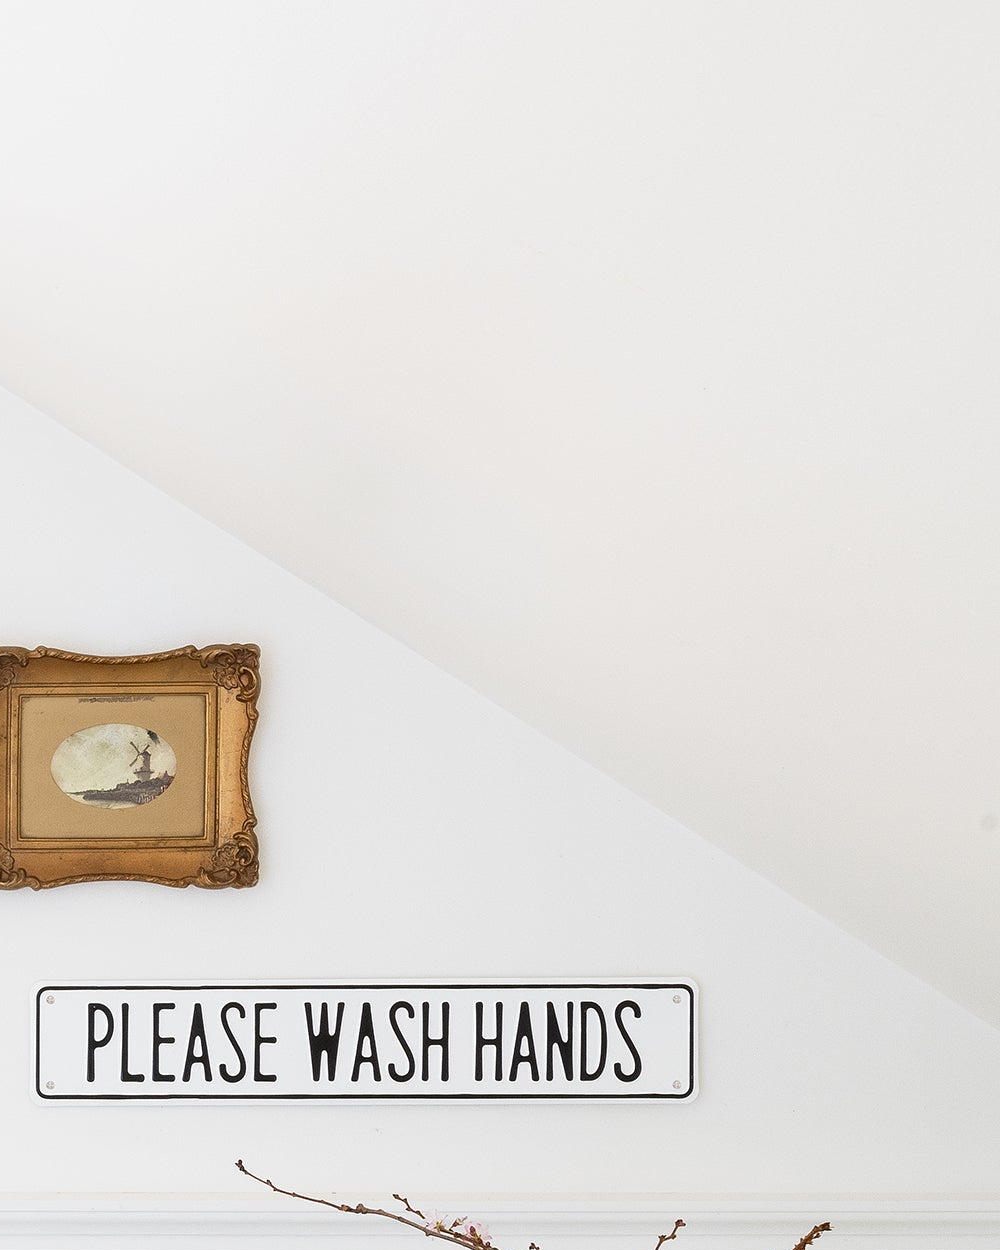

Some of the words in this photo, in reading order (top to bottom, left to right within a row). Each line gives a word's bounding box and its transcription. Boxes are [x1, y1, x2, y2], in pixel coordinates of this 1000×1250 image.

[84, 1001, 279, 1083] PLEASE
[303, 1001, 450, 1082] WASH
[473, 1000, 643, 1082] HANDS
